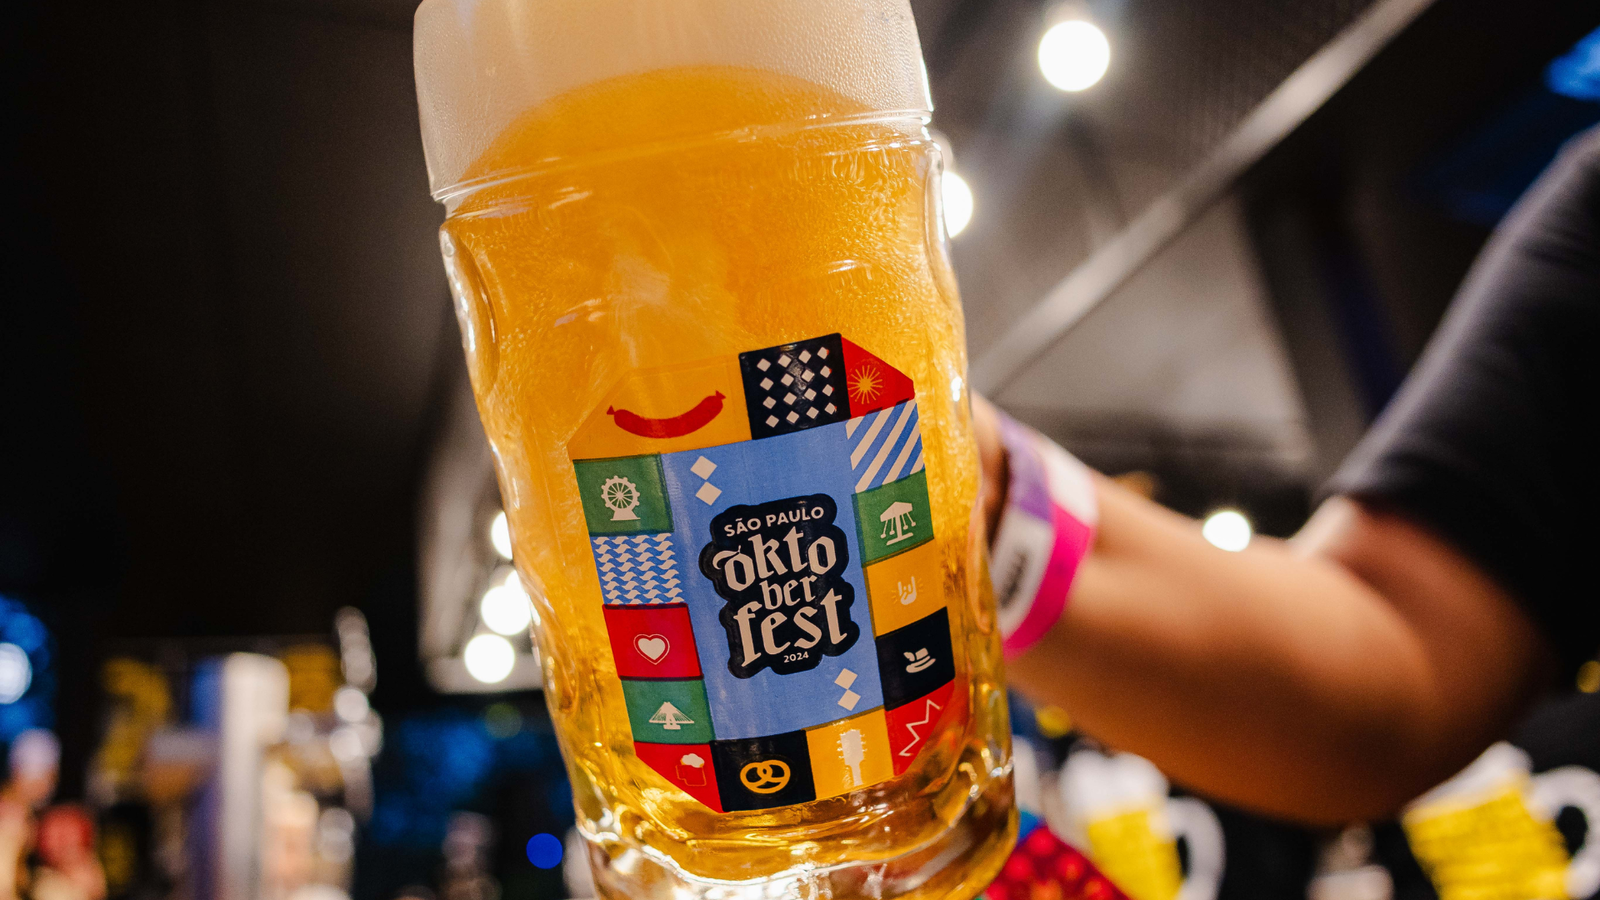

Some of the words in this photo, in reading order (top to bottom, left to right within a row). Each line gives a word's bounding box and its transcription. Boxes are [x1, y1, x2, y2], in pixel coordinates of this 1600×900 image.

[724, 517, 762, 537] SÃO
[765, 506, 825, 528] PAULO
[712, 526, 837, 592] okto
[759, 574, 817, 610] ber
[733, 588, 847, 667] fest
[783, 651, 809, 663] 2024
